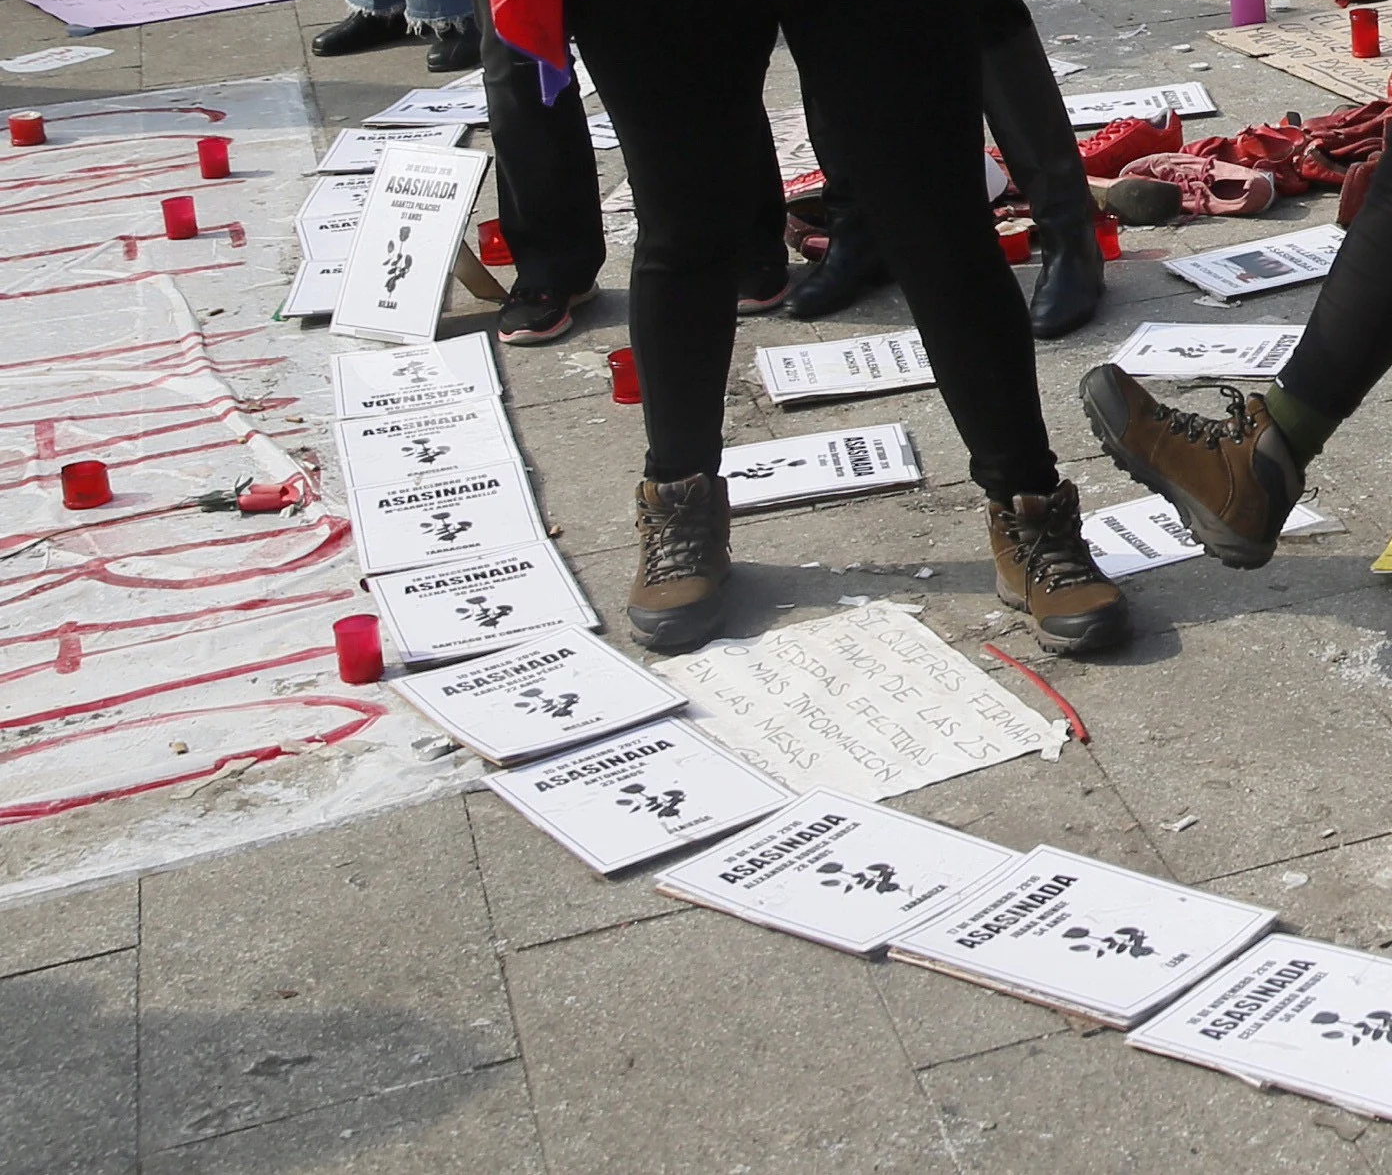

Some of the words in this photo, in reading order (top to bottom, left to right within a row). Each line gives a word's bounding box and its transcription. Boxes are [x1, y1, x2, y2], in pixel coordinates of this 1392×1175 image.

[385, 175, 458, 200] ASASINADA
[361, 385, 475, 409] ASASINADA
[843, 436, 875, 477] ASASINADA
[377, 478, 501, 510] ASASINADA
[403, 558, 535, 597] ASASINADA
[441, 646, 576, 698] ASASINADA
[764, 633, 851, 698] MEDIDAS
[845, 695, 938, 768] EFECTIVAS
[829, 633, 886, 681] FAVOR
[880, 673, 925, 704] DE
[915, 700, 962, 739] LAS
[952, 731, 1001, 762] 25
[877, 628, 967, 693] QUIERES
[968, 687, 1044, 748] FIRMAR
[685, 658, 718, 684] EN
[714, 685, 755, 716] LAS
[754, 716, 823, 771] MESAS
[747, 659, 793, 697] MÁS
[784, 691, 903, 784] INFORMACIÓN
[532, 737, 675, 794] ASASINADA
[717, 812, 849, 885] ASASINADA
[955, 872, 1080, 951] ASASINADA
[1199, 957, 1318, 1042] ASASINADA
